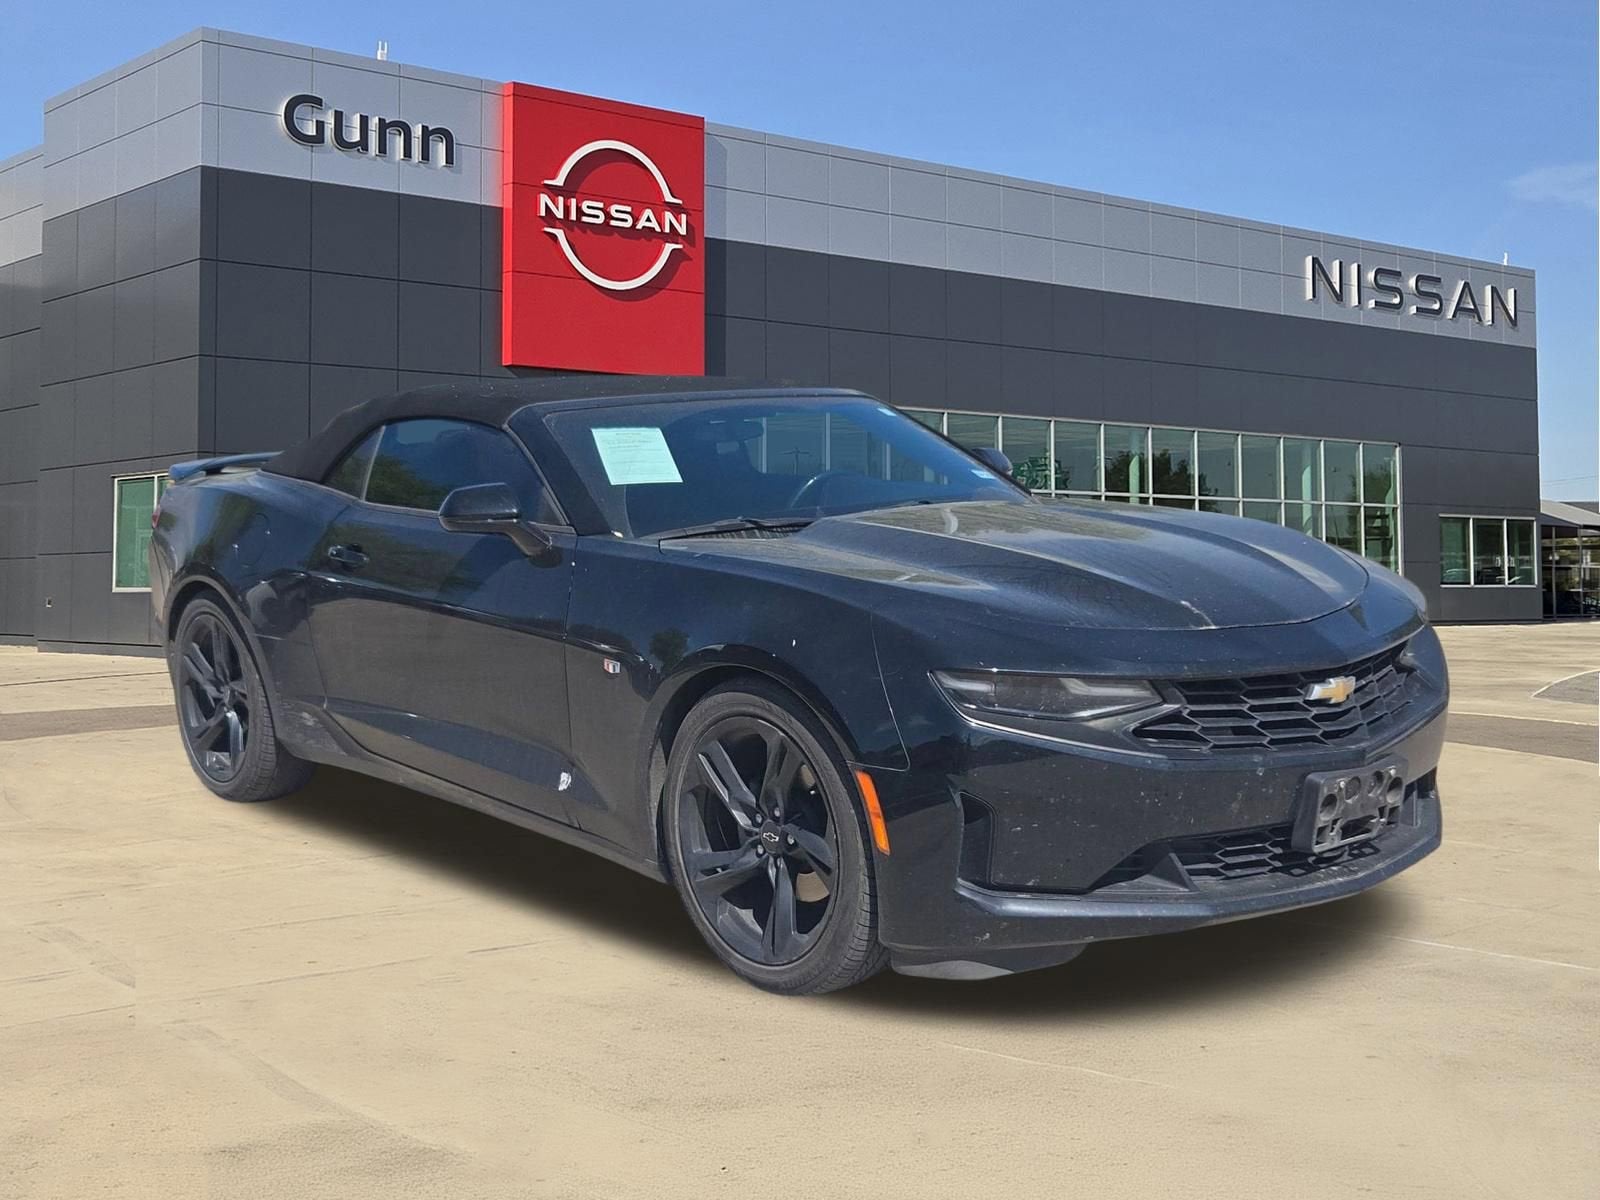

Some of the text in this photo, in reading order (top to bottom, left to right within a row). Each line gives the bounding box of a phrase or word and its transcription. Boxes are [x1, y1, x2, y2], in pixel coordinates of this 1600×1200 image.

[282, 94, 455, 166] Gunn
[538, 193, 687, 235] NISSAN
[1306, 255, 1517, 327] NISSAN
